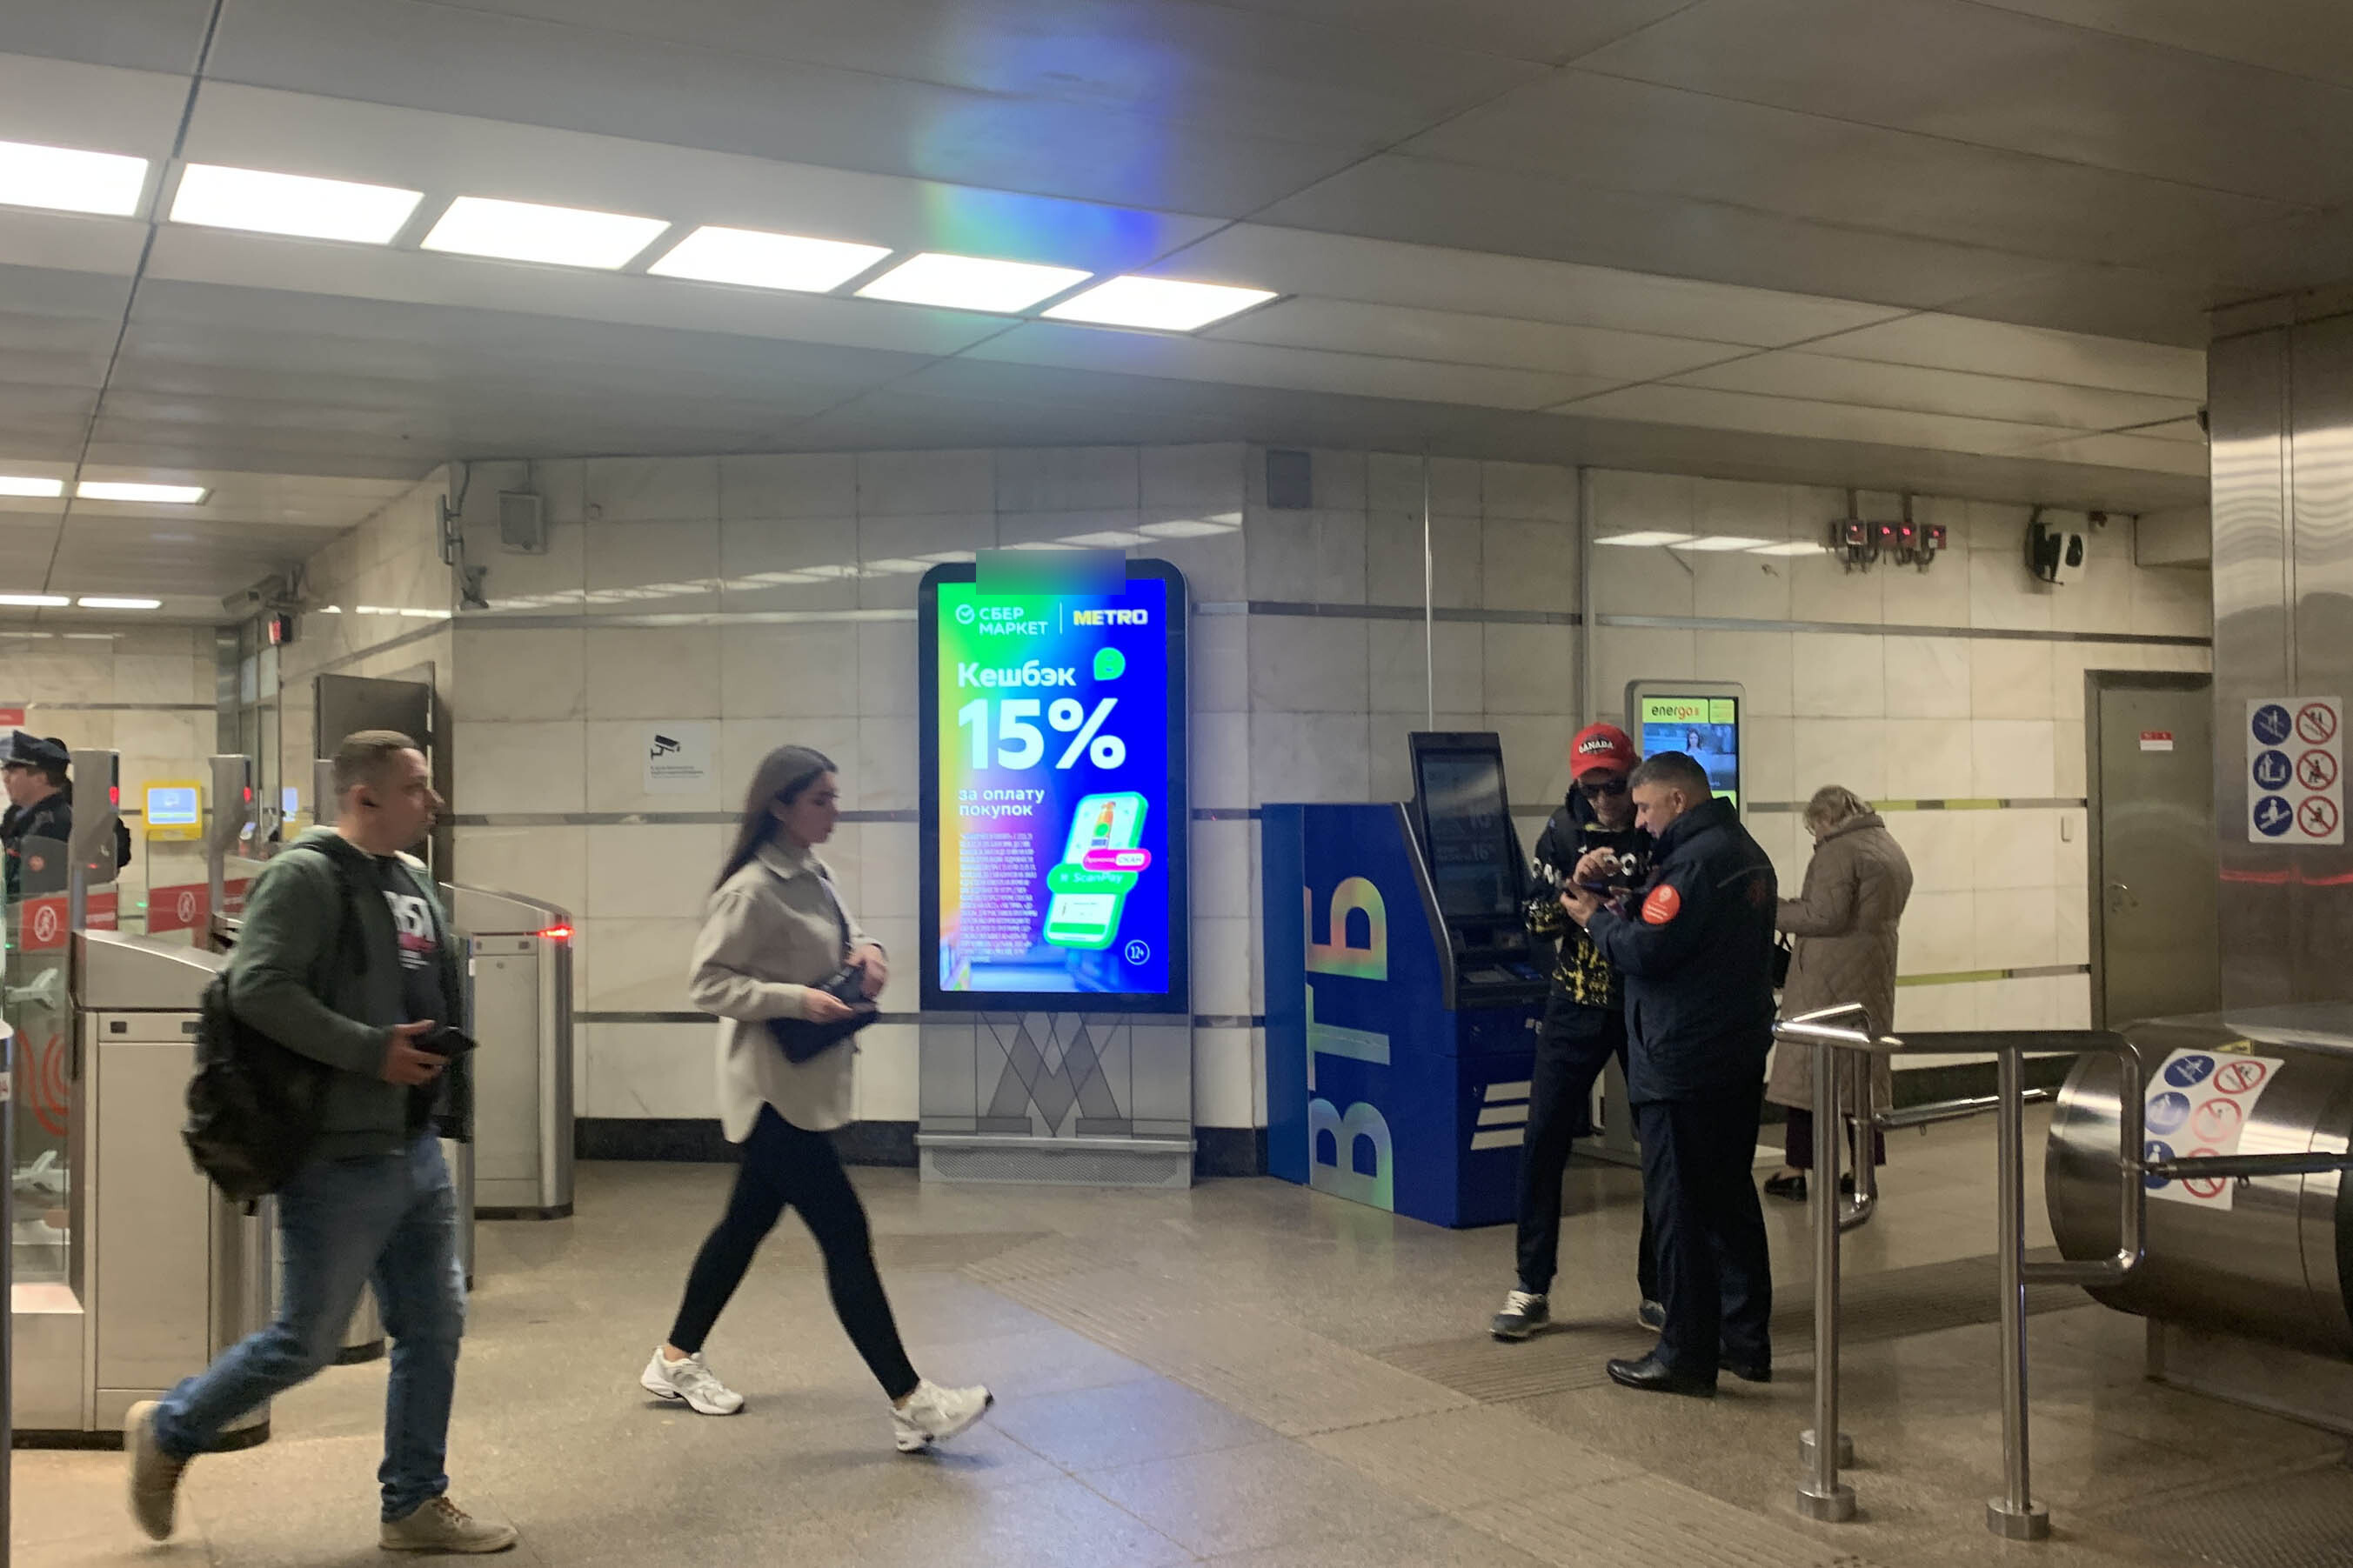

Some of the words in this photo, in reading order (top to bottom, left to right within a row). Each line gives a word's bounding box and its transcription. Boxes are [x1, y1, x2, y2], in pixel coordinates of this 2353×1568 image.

[979, 607, 1024, 620] СБЕР
[1073, 610, 1148, 625] METRO
[979, 621, 1048, 636] МАРКЕТ
[958, 659, 1076, 687] Кешбэк
[958, 697, 1126, 771] 15%
[1578, 740, 1614, 754] CANADA
[959, 790, 978, 801] за
[983, 789, 1045, 804] оплату
[959, 804, 1033, 819] покупок
[1303, 876, 1394, 1213] ВТБ
